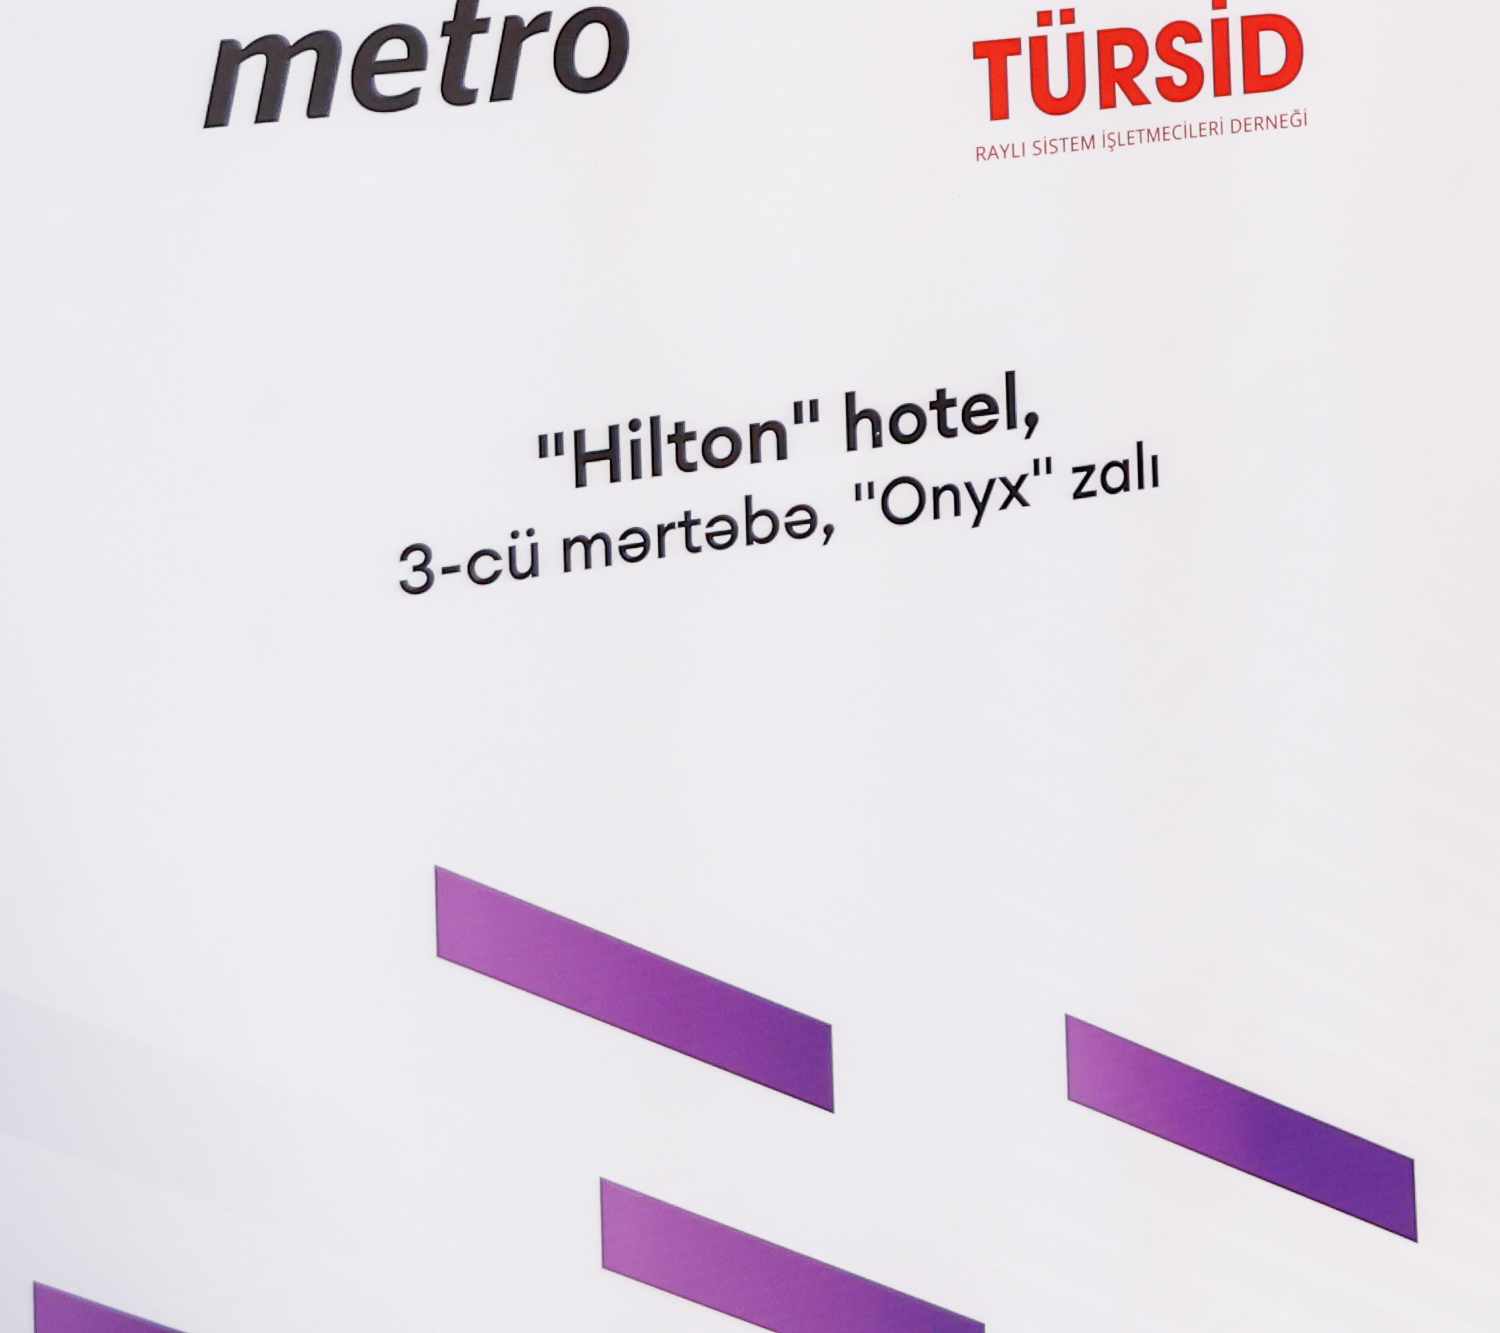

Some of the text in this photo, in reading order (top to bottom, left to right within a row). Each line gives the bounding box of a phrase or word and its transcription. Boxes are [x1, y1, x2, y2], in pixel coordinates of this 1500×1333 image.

[975, 108, 1309, 162] RAYLI SİSTEM İŞLETMECİLERİ DERNEĞİ
[537, 370, 1041, 489] "Hilton" hotel,
[399, 440, 1160, 596] 3-cü mərtəbə, "Onyx" zalı
